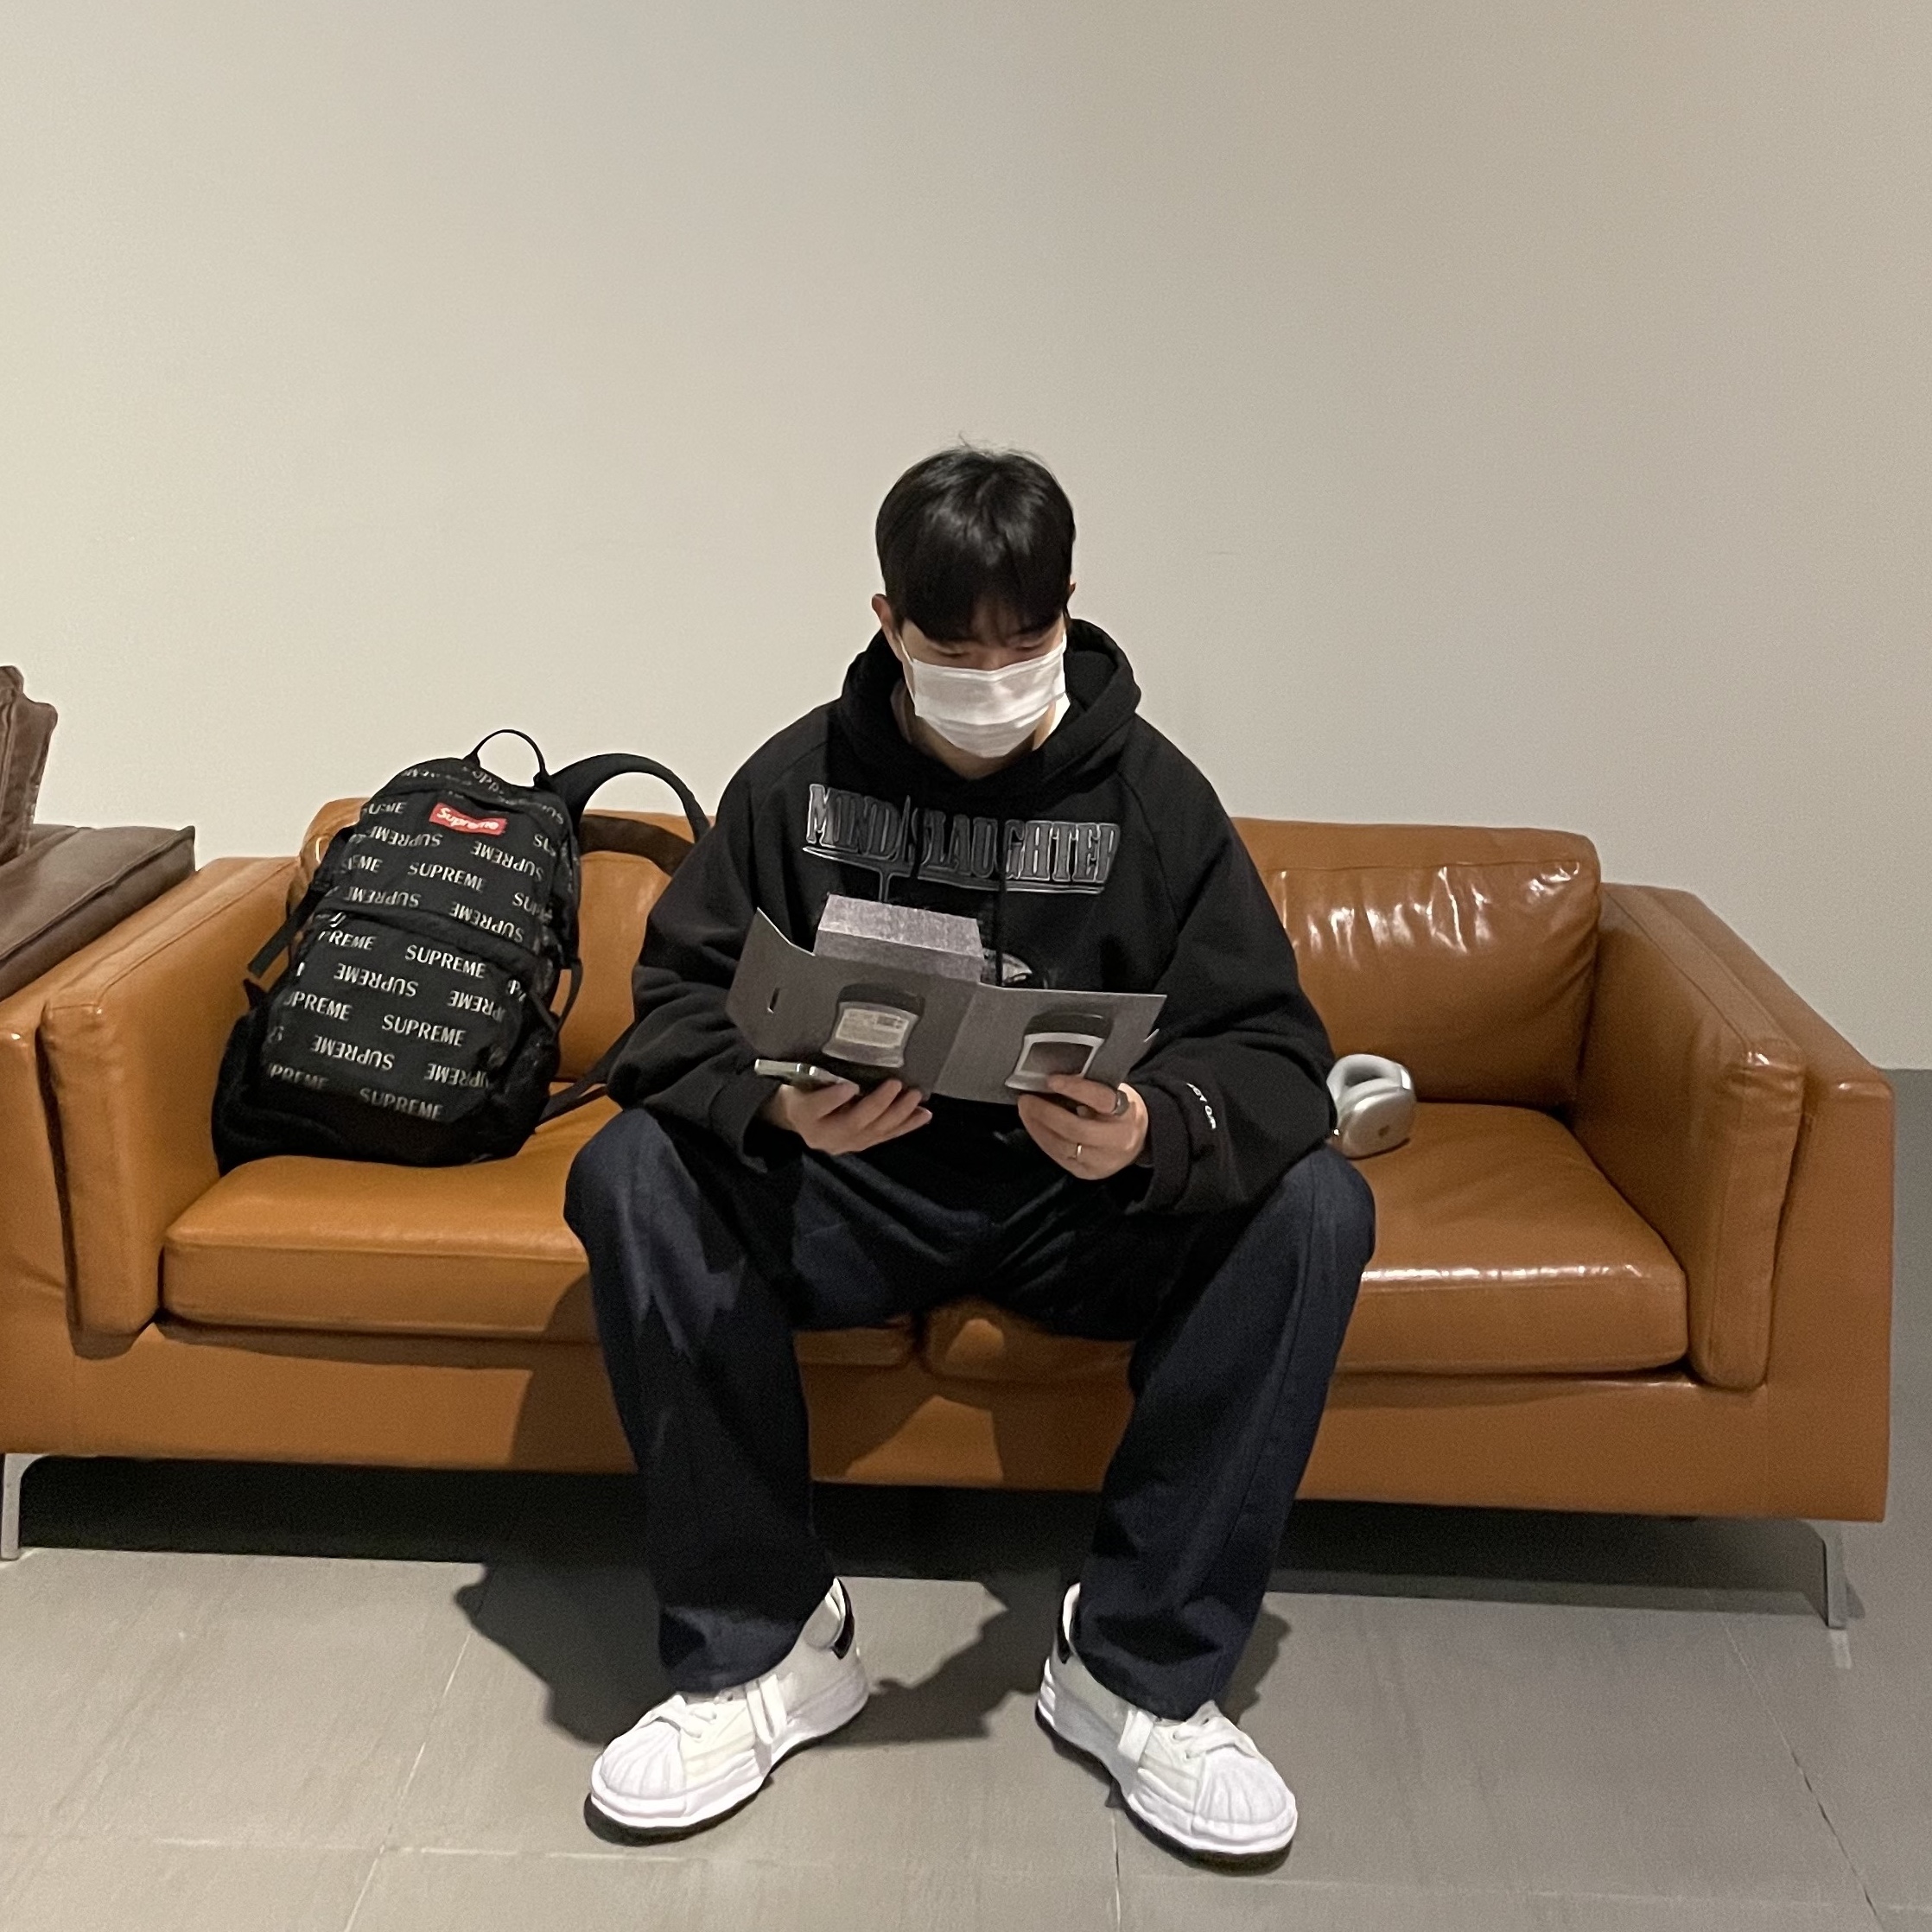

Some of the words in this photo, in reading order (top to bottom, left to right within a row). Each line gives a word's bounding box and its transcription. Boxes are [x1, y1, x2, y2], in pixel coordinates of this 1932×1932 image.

[436, 807, 499, 830] Supreme
[470, 841, 544, 882] SUPREME
[448, 900, 525, 944] SUPREME
[404, 944, 486, 979] SUPREME
[334, 963, 419, 997] SUPREME
[381, 1014, 467, 1047] SUPREME
[310, 1034, 396, 1071] SUPREME
[359, 1087, 444, 1121] SUPREME
